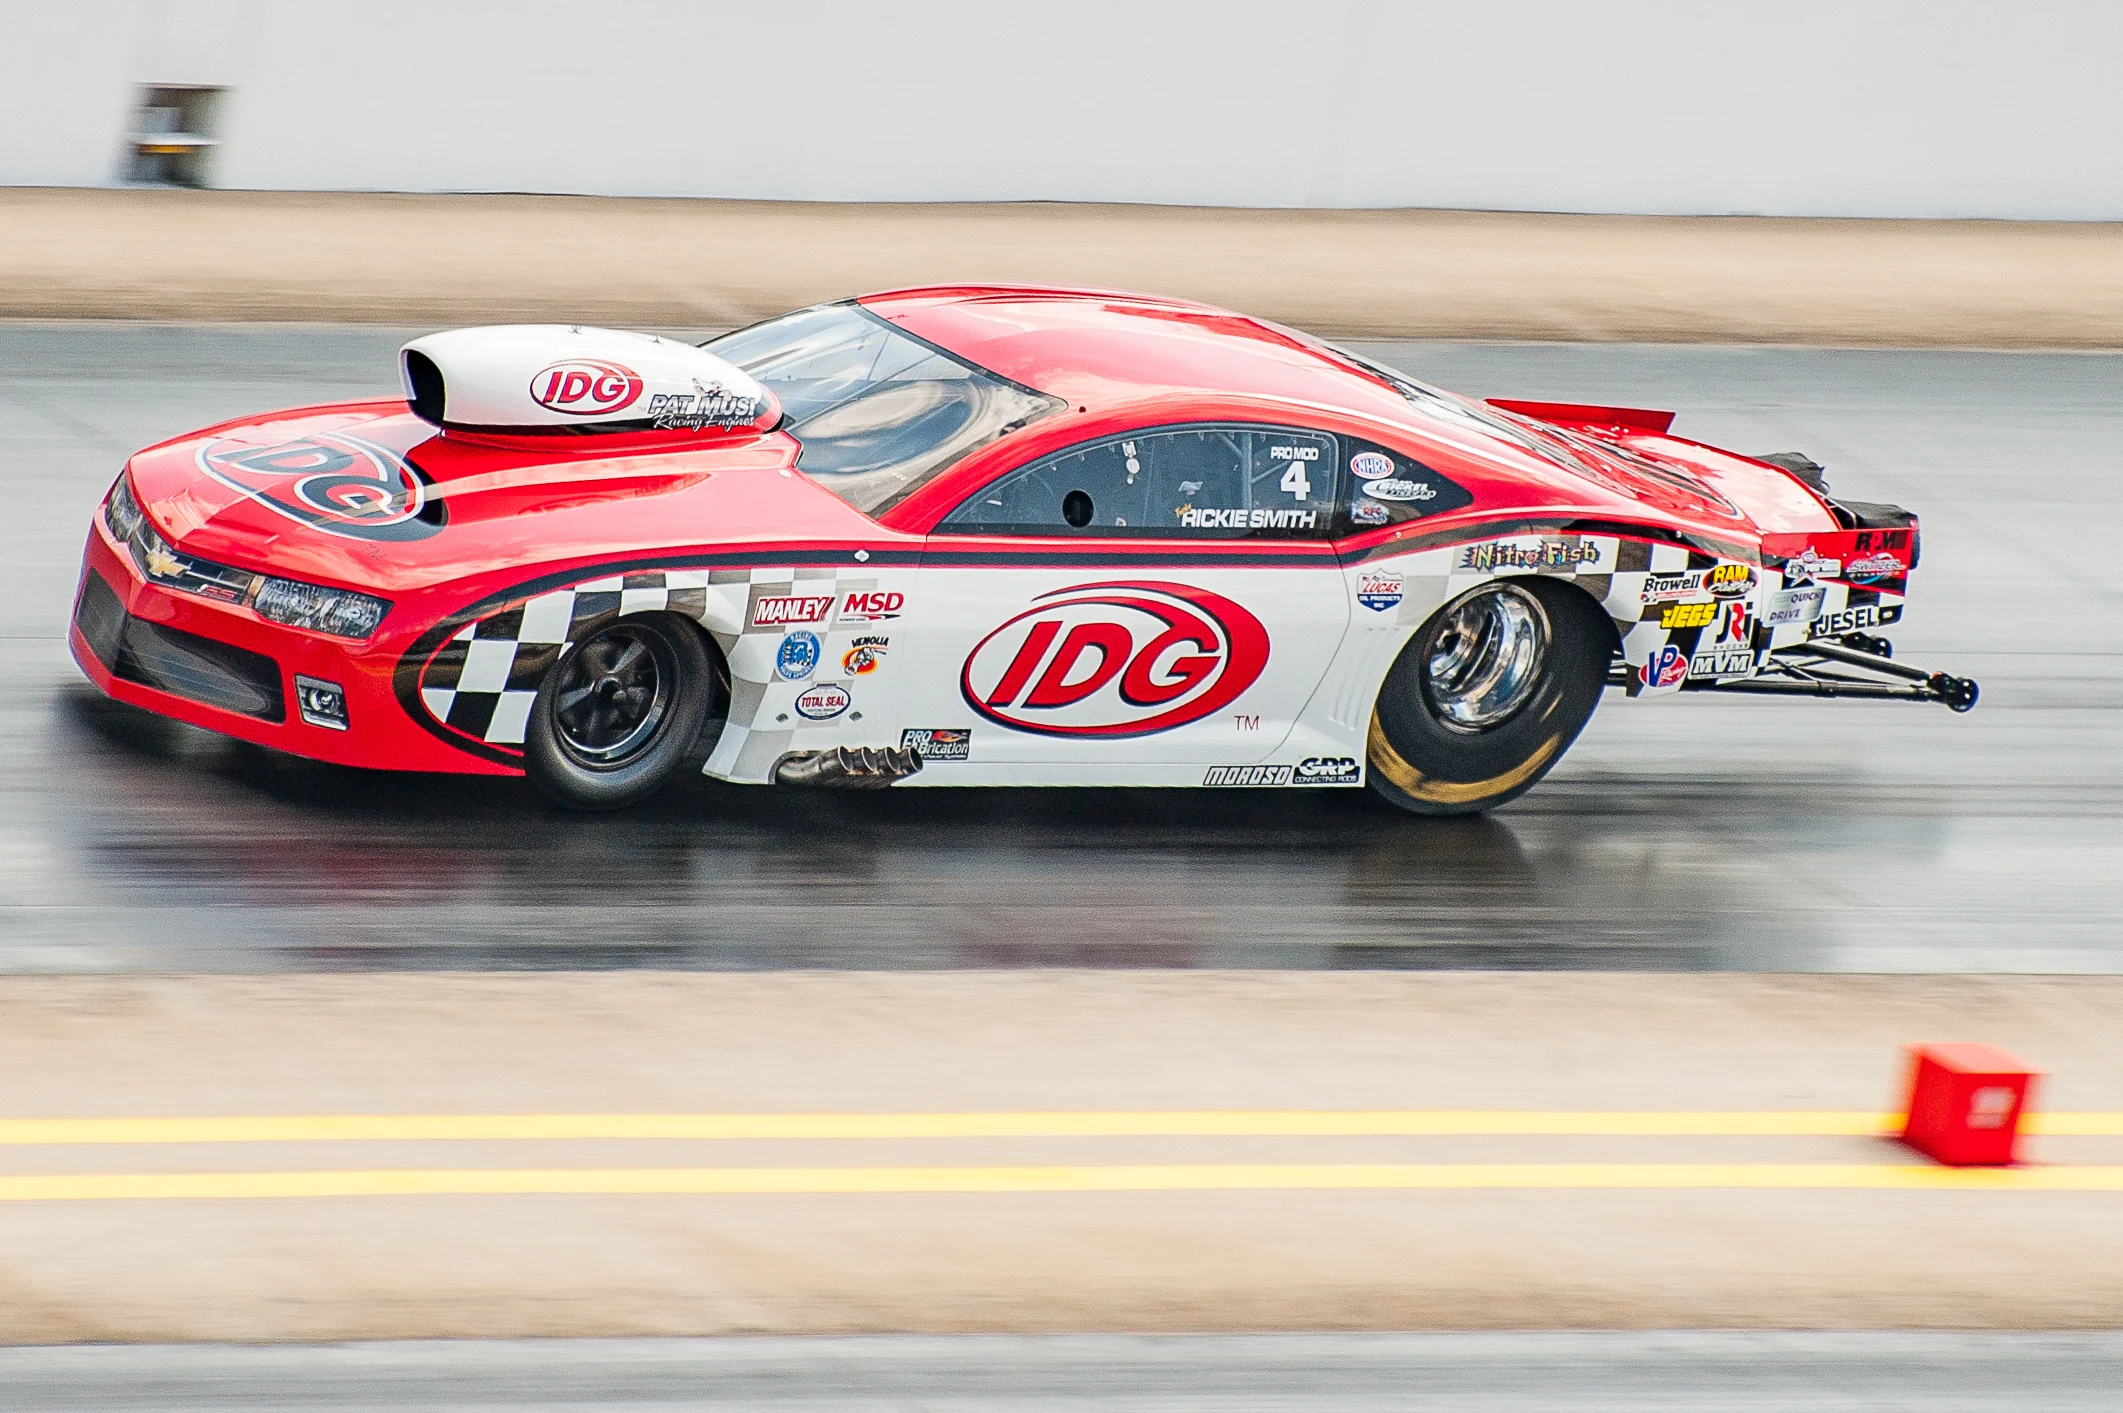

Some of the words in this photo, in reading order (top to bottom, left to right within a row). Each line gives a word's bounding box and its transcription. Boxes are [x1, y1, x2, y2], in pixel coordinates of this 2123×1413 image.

[542, 371, 626, 403] IDG
[648, 394, 695, 414] PAT
[695, 396, 756, 416] MUSI
[653, 413, 703, 432] Racing
[705, 414, 755, 433] Engines
[1271, 446, 1293, 460] PRO
[1293, 447, 1319, 461] MOD
[1356, 458, 1389, 474] NHRA
[1281, 460, 1311, 501] 4
[1181, 508, 1249, 528] RICKIE
[1249, 509, 1317, 529] SMITH
[1470, 543, 1539, 569] Nitro
[1543, 541, 1598, 565] Fish
[1643, 574, 1700, 592] Browell
[1713, 566, 1749, 583] RAM
[1362, 582, 1401, 593] LUCAS
[843, 592, 904, 613] MSD
[1790, 592, 1820, 603] QUICK
[756, 599, 826, 621] MANLEY
[1661, 603, 1717, 628] JEGS
[1769, 608, 1801, 620] DRIVE
[1819, 608, 1878, 635] JESEL
[986, 620, 1222, 707] IDG
[1649, 647, 1679, 687] VP
[1693, 651, 1750, 674] MVM
[802, 696, 823, 708] TOTAL
[826, 696, 845, 707] SEAL
[1234, 715, 1260, 731] TM
[904, 731, 933, 743] PRO
[1204, 766, 1291, 785] MOROSO
[1299, 757, 1355, 776] GRP
[1295, 775, 1337, 783] CONNECTING
[1338, 775, 1357, 783] RODS
